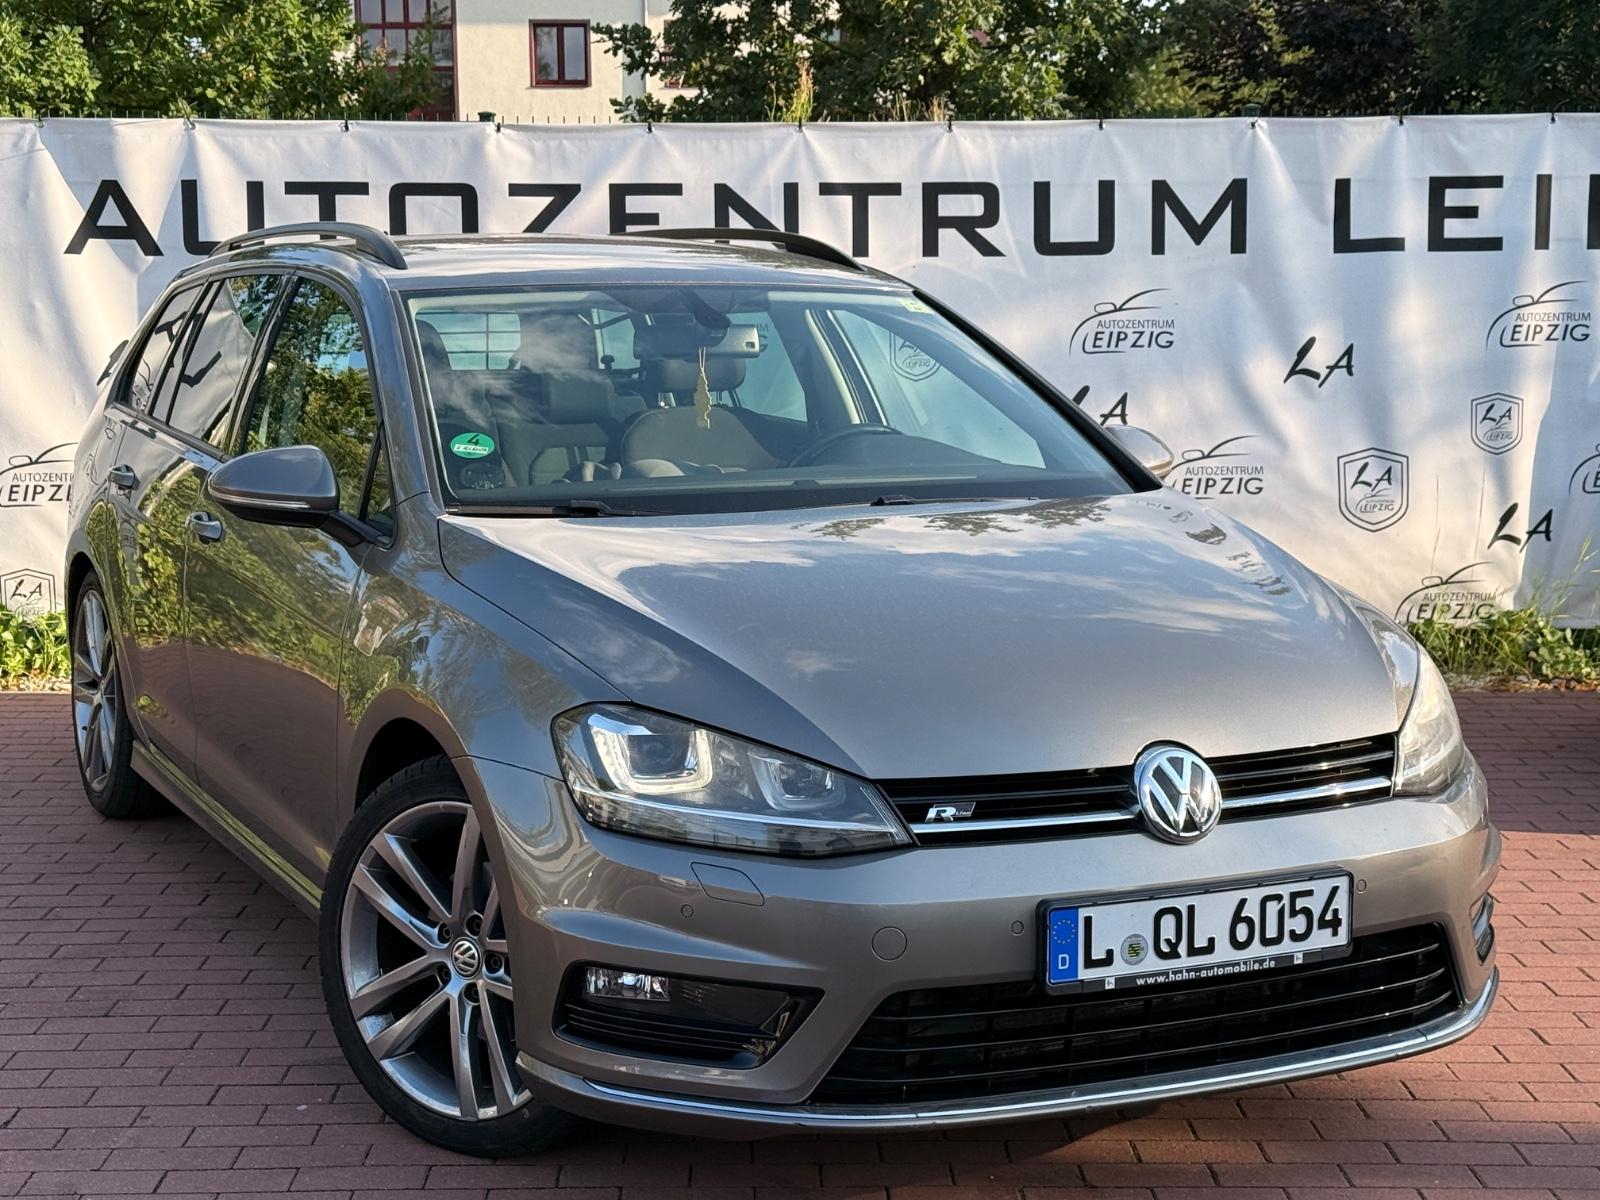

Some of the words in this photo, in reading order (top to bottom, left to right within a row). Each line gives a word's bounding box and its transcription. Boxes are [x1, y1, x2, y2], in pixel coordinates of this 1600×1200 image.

[64, 178, 1248, 257] AUTOZENTRUM
[1333, 174, 1600, 253] LEI
[1097, 319, 1175, 329] AUTOZENTRUM
[1515, 312, 1591, 322] AUTOZENTRUM
[1284, 336, 1354, 388] LA
[1480, 403, 1512, 425] LA
[467, 434, 480, 446] 4
[1185, 466, 1264, 476] AUTOZENTRUM
[1351, 462, 1392, 492] LA
[1487, 503, 1553, 553] LA
[10, 579, 42, 601] LA
[1423, 592, 1496, 601] AUTOZENTRUM
[1083, 915, 1114, 969] L
[1153, 904, 1216, 960] QL
[1229, 885, 1342, 951] 6054
[1058, 953, 1070, 970] D
[1136, 958, 1276, 987] www.hahn-automobile.de
